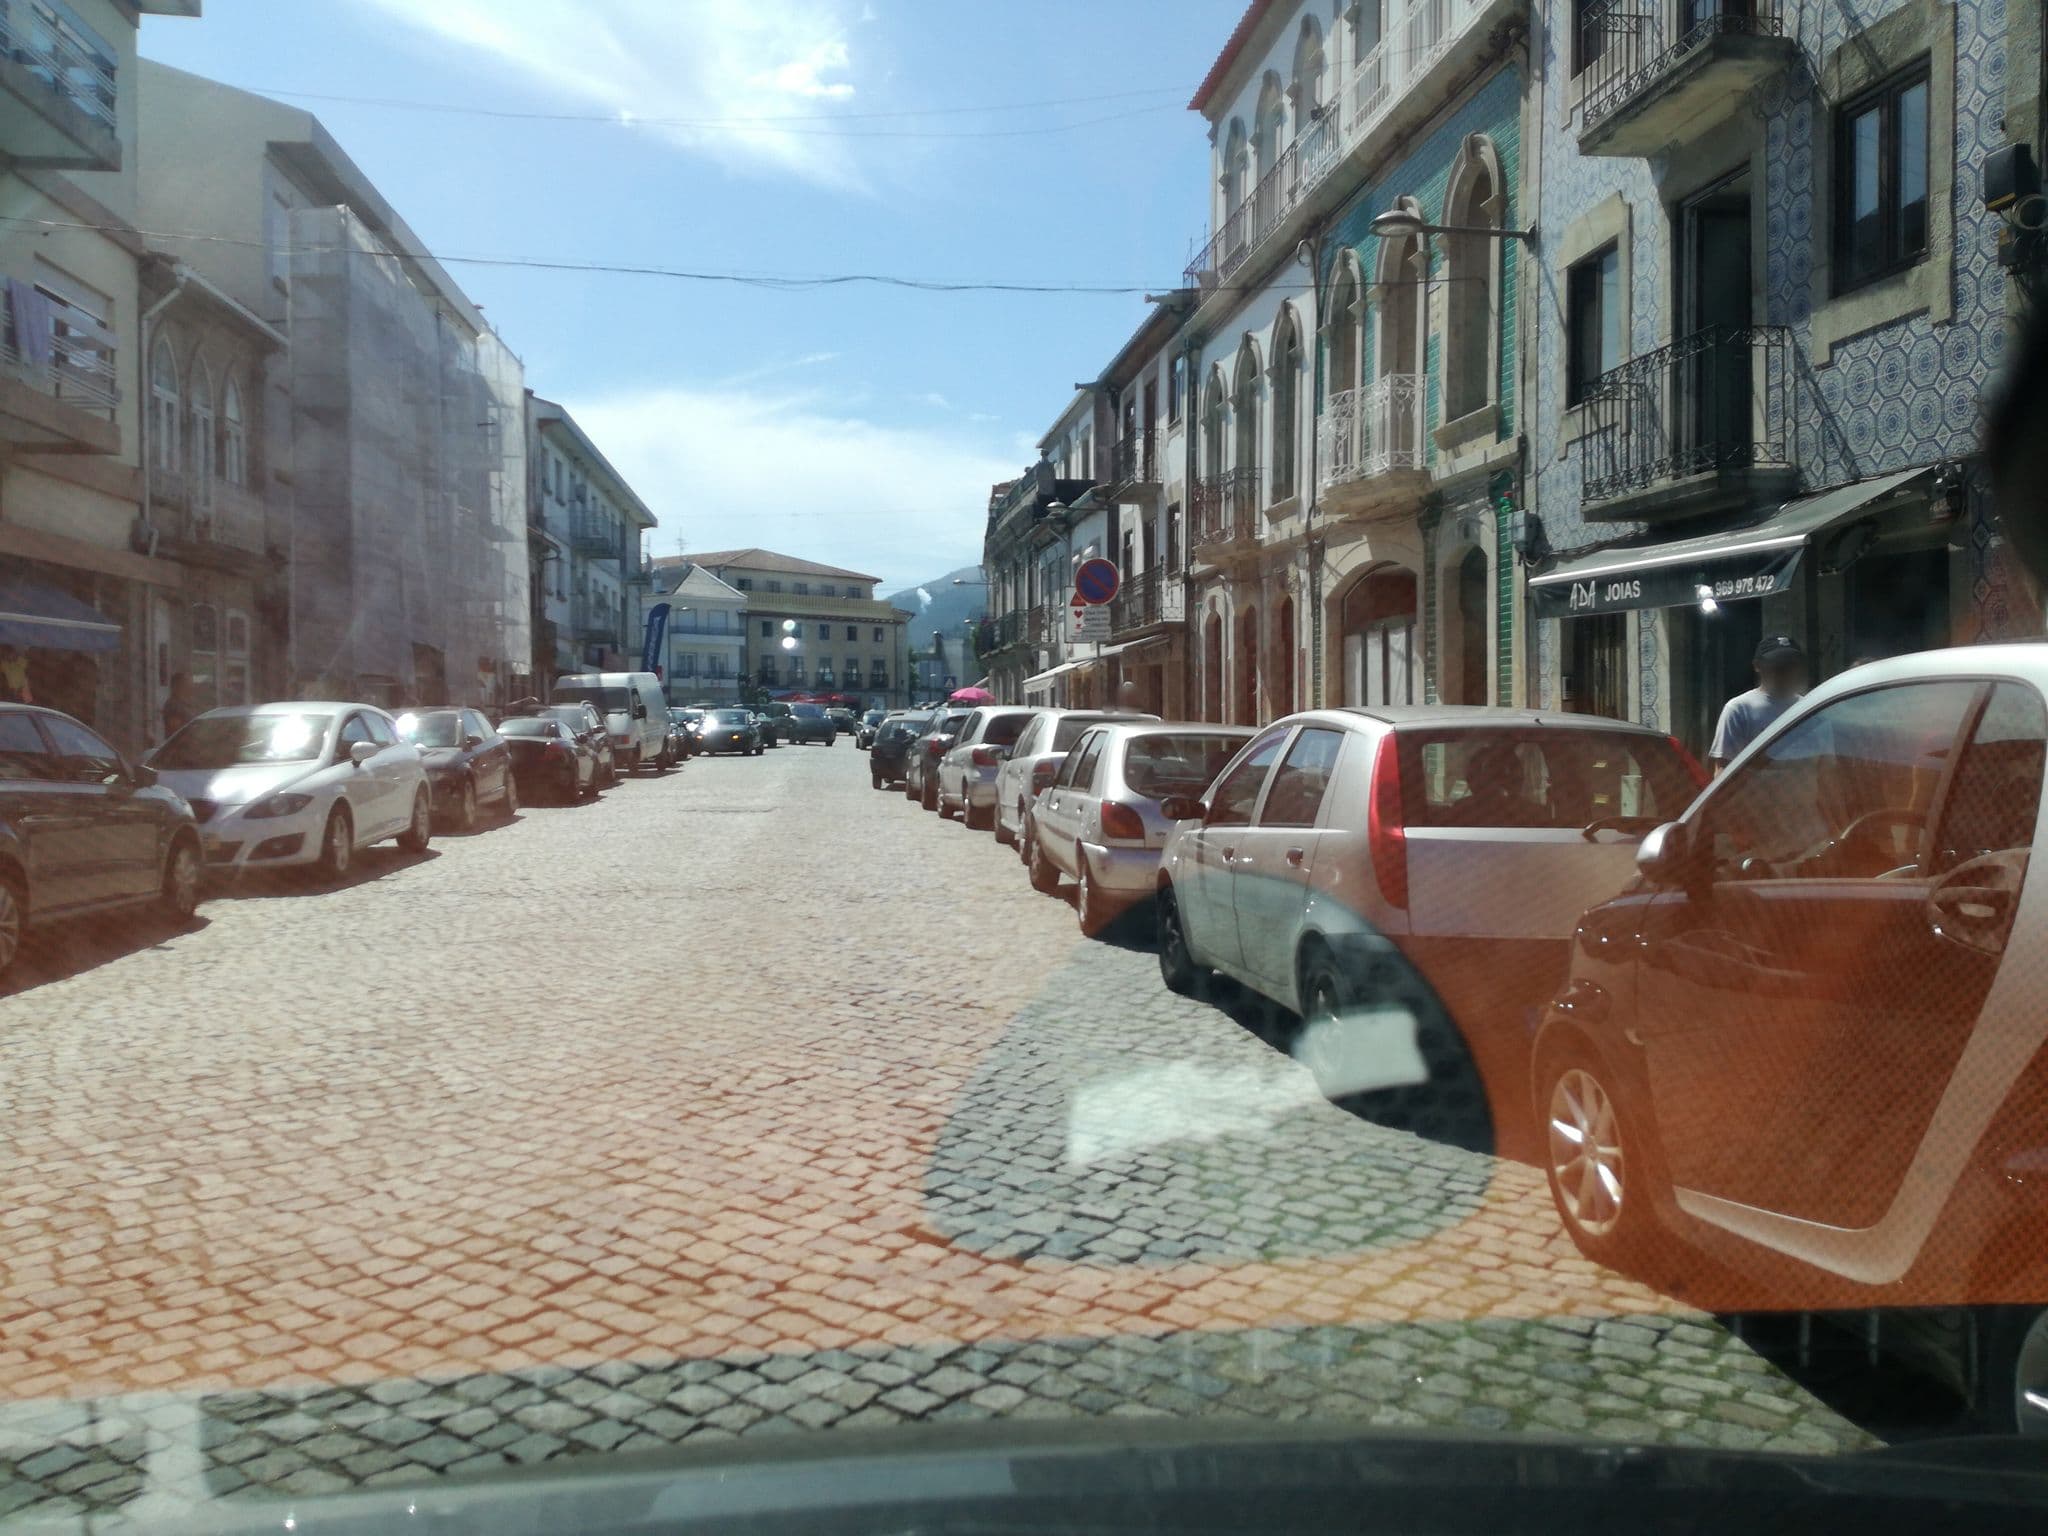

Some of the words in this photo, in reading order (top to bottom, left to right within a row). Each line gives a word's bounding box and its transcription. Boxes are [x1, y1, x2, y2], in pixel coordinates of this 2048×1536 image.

[1569, 580, 1596, 610] ADA
[1604, 580, 1640, 602] JOIAS
[1715, 581, 1733, 596] 969
[1735, 577, 1754, 593] 978
[1755, 575, 1775, 591] 472
